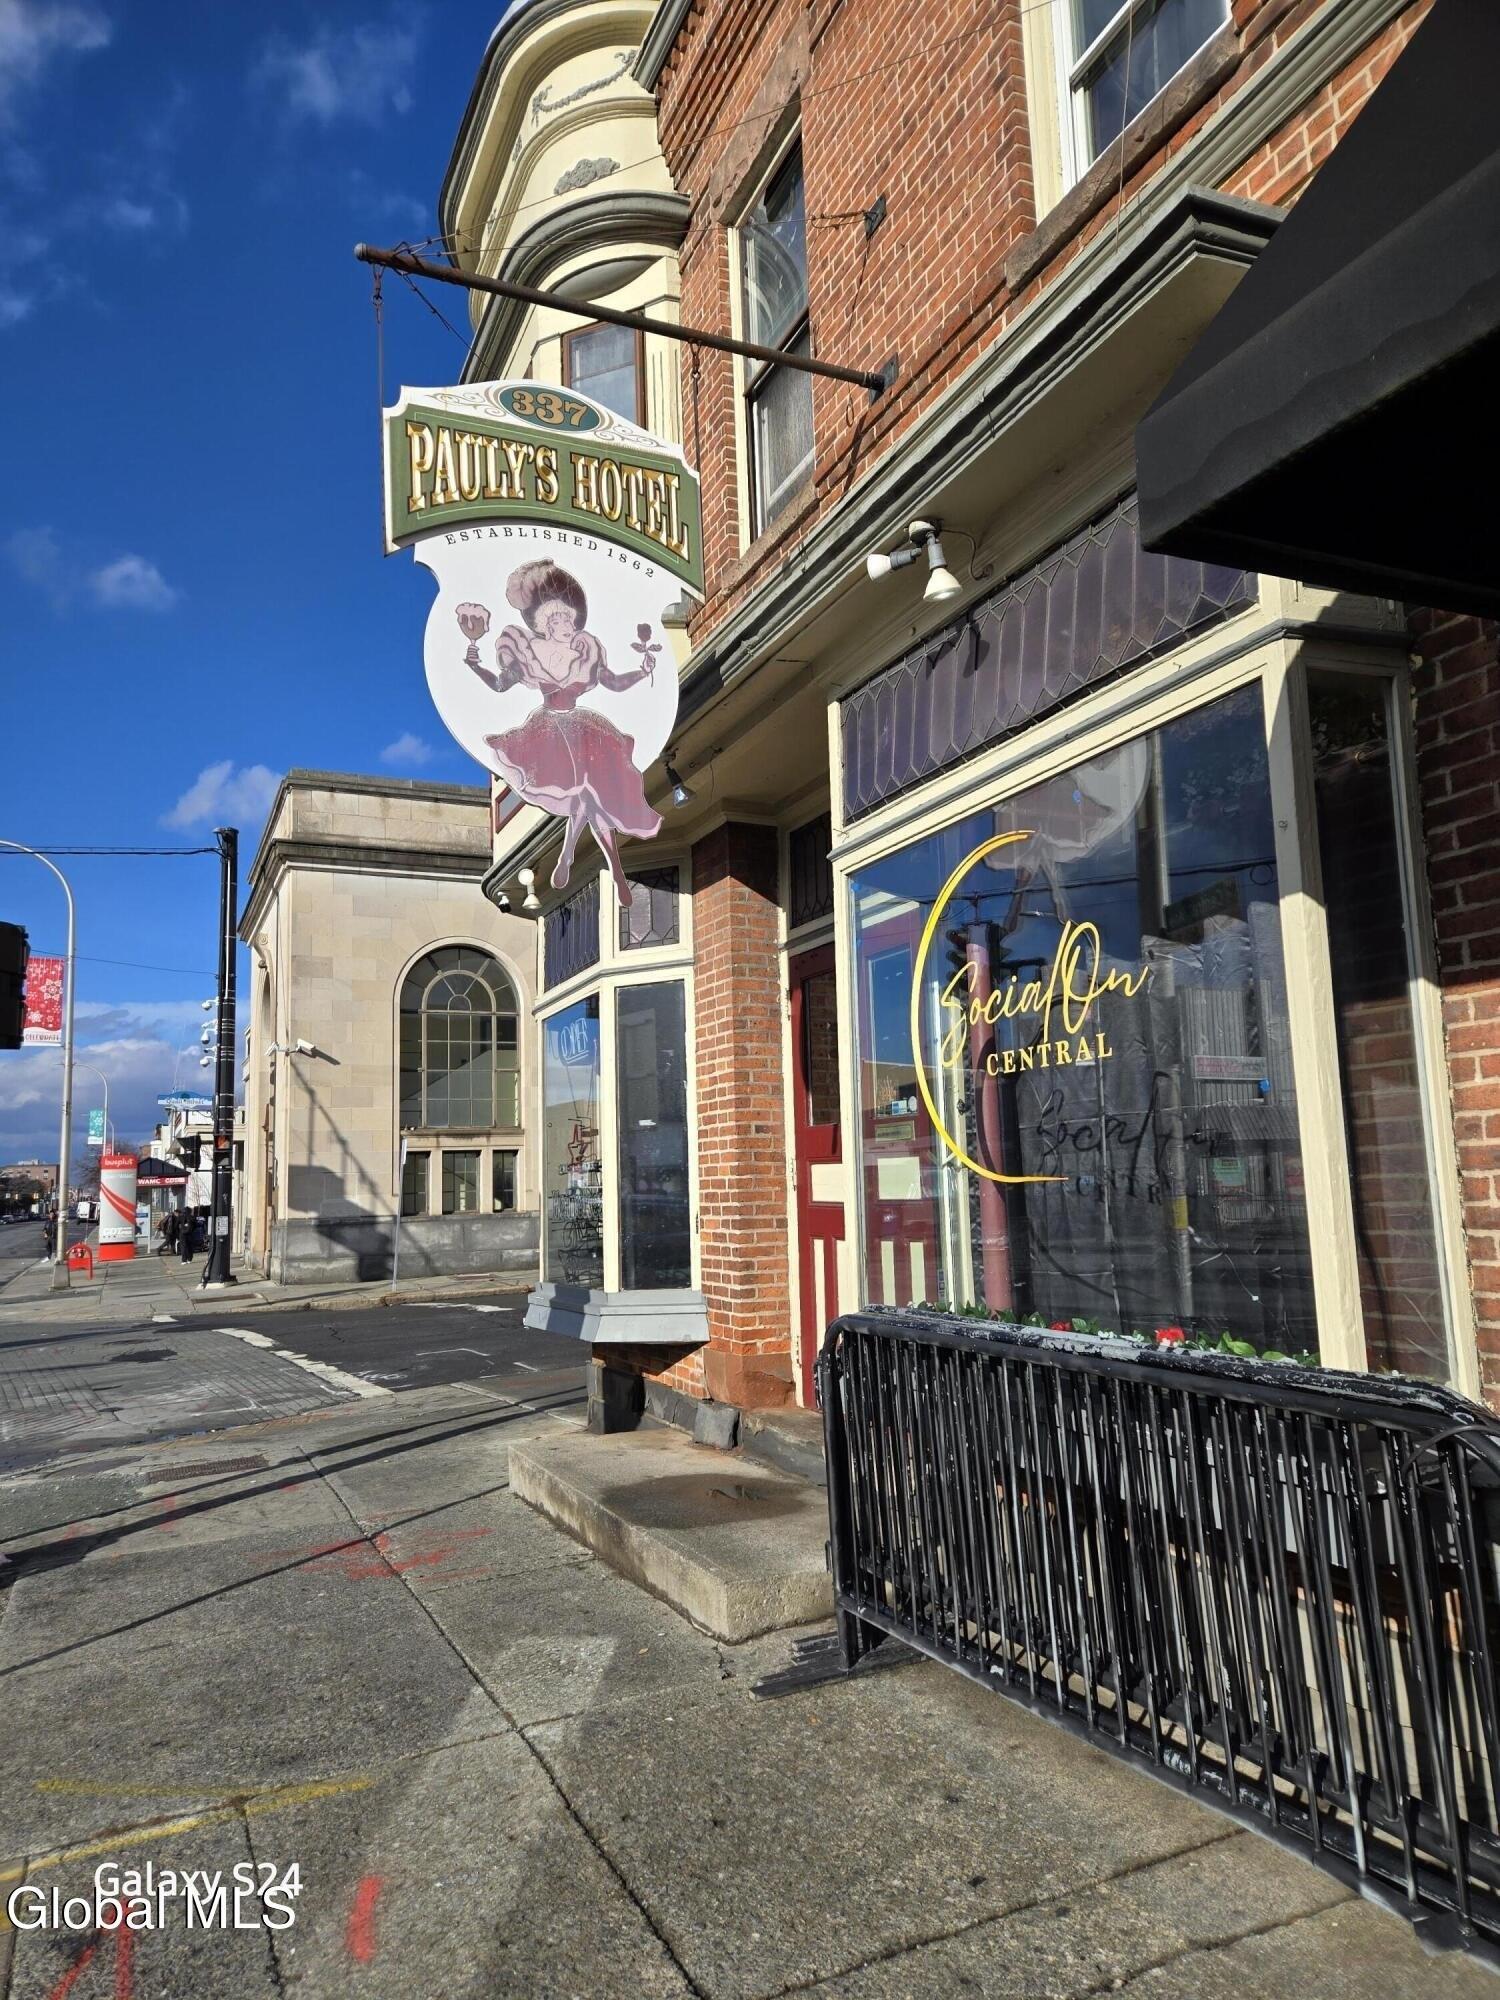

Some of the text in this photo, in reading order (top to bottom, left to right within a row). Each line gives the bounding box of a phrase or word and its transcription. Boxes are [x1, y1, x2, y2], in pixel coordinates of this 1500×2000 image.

[512, 389, 589, 427] 337
[406, 420, 690, 563] PAULY'S HOTEL
[446, 526, 654, 578] ESTABLISHED 1862
[941, 920, 1149, 1067] Social On
[986, 1032, 1113, 1076] CENTRAL
